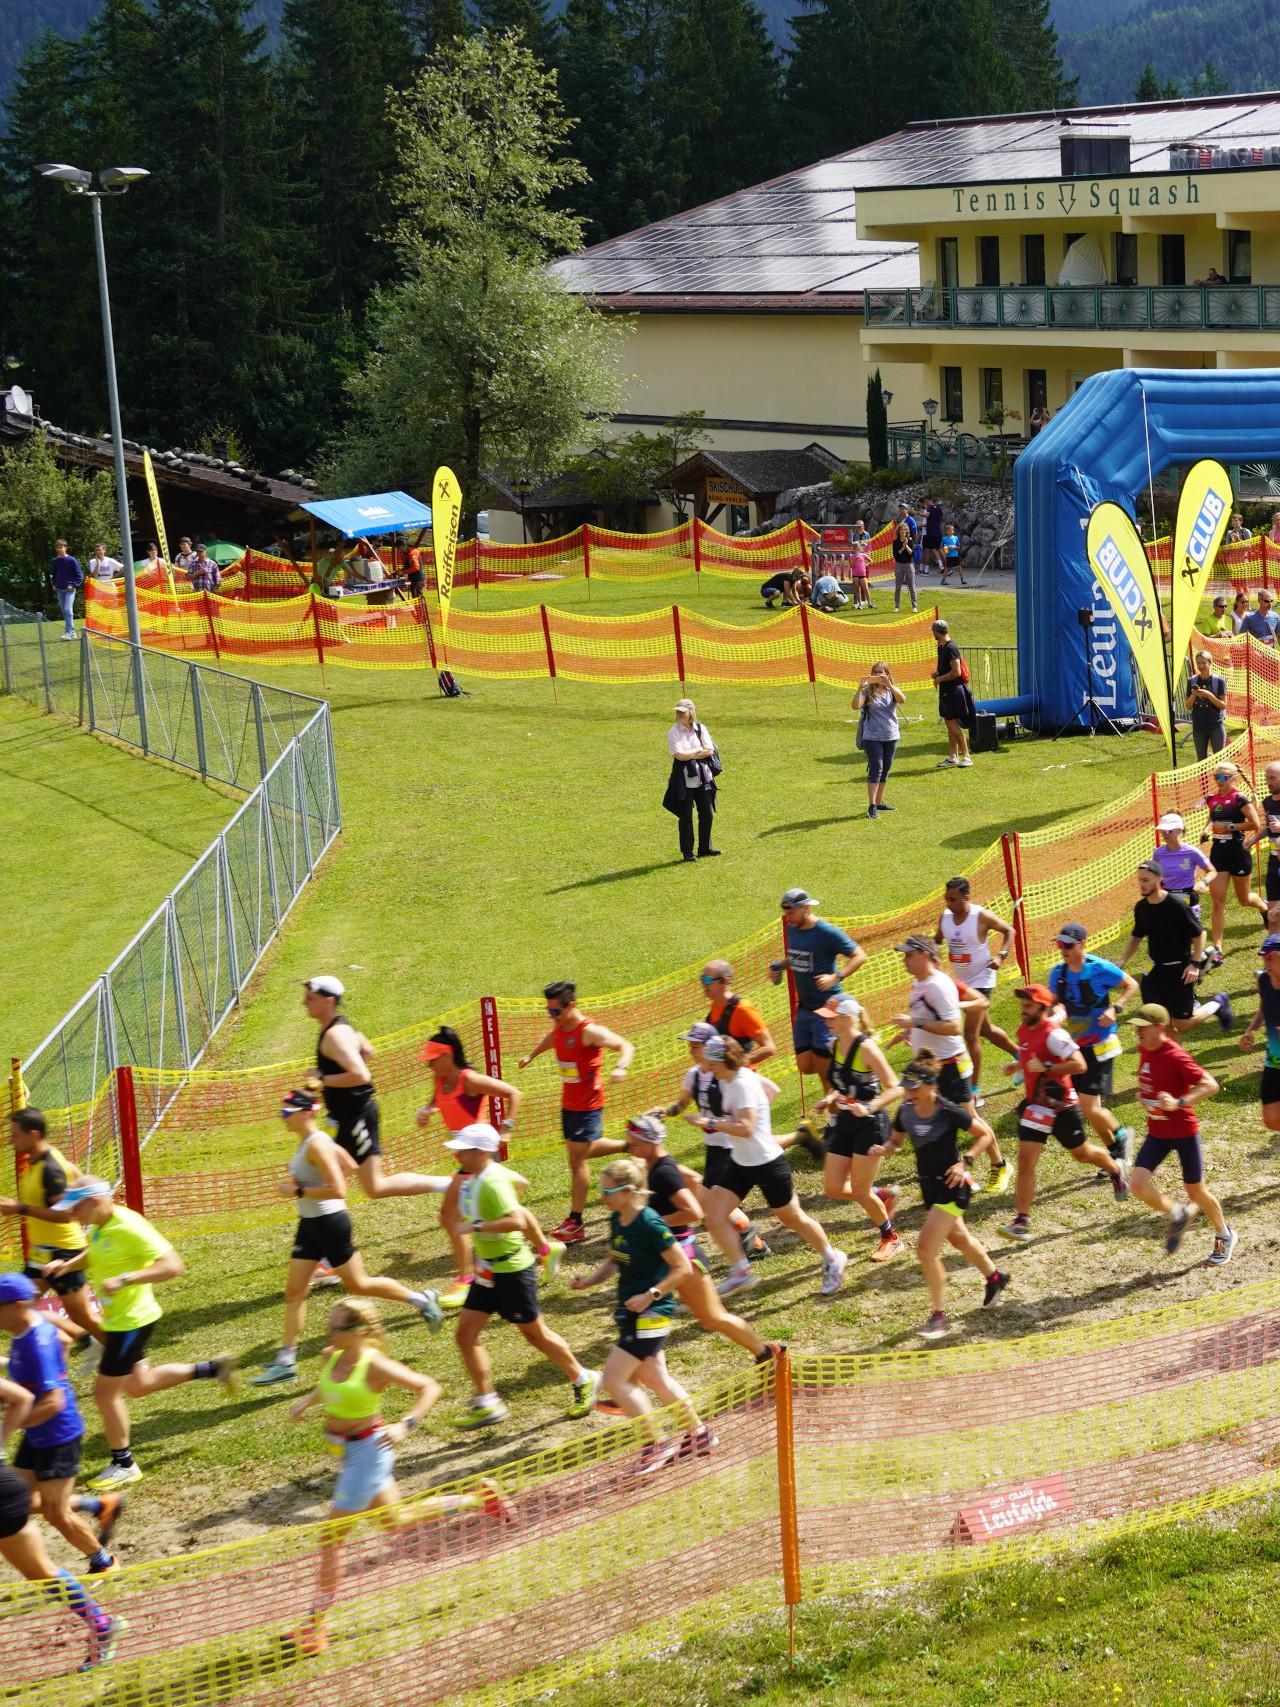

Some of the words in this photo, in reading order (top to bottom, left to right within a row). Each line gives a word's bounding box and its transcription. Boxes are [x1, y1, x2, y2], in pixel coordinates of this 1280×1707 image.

[953, 185, 1045, 213] Tennis
[1089, 176, 1200, 215] Squash
[710, 480, 746, 495] SKISCHUL
[441, 504, 459, 599] Raiffeisen
[1189, 491, 1223, 564] CLUB
[484, 1001, 502, 1126] WEINGST
